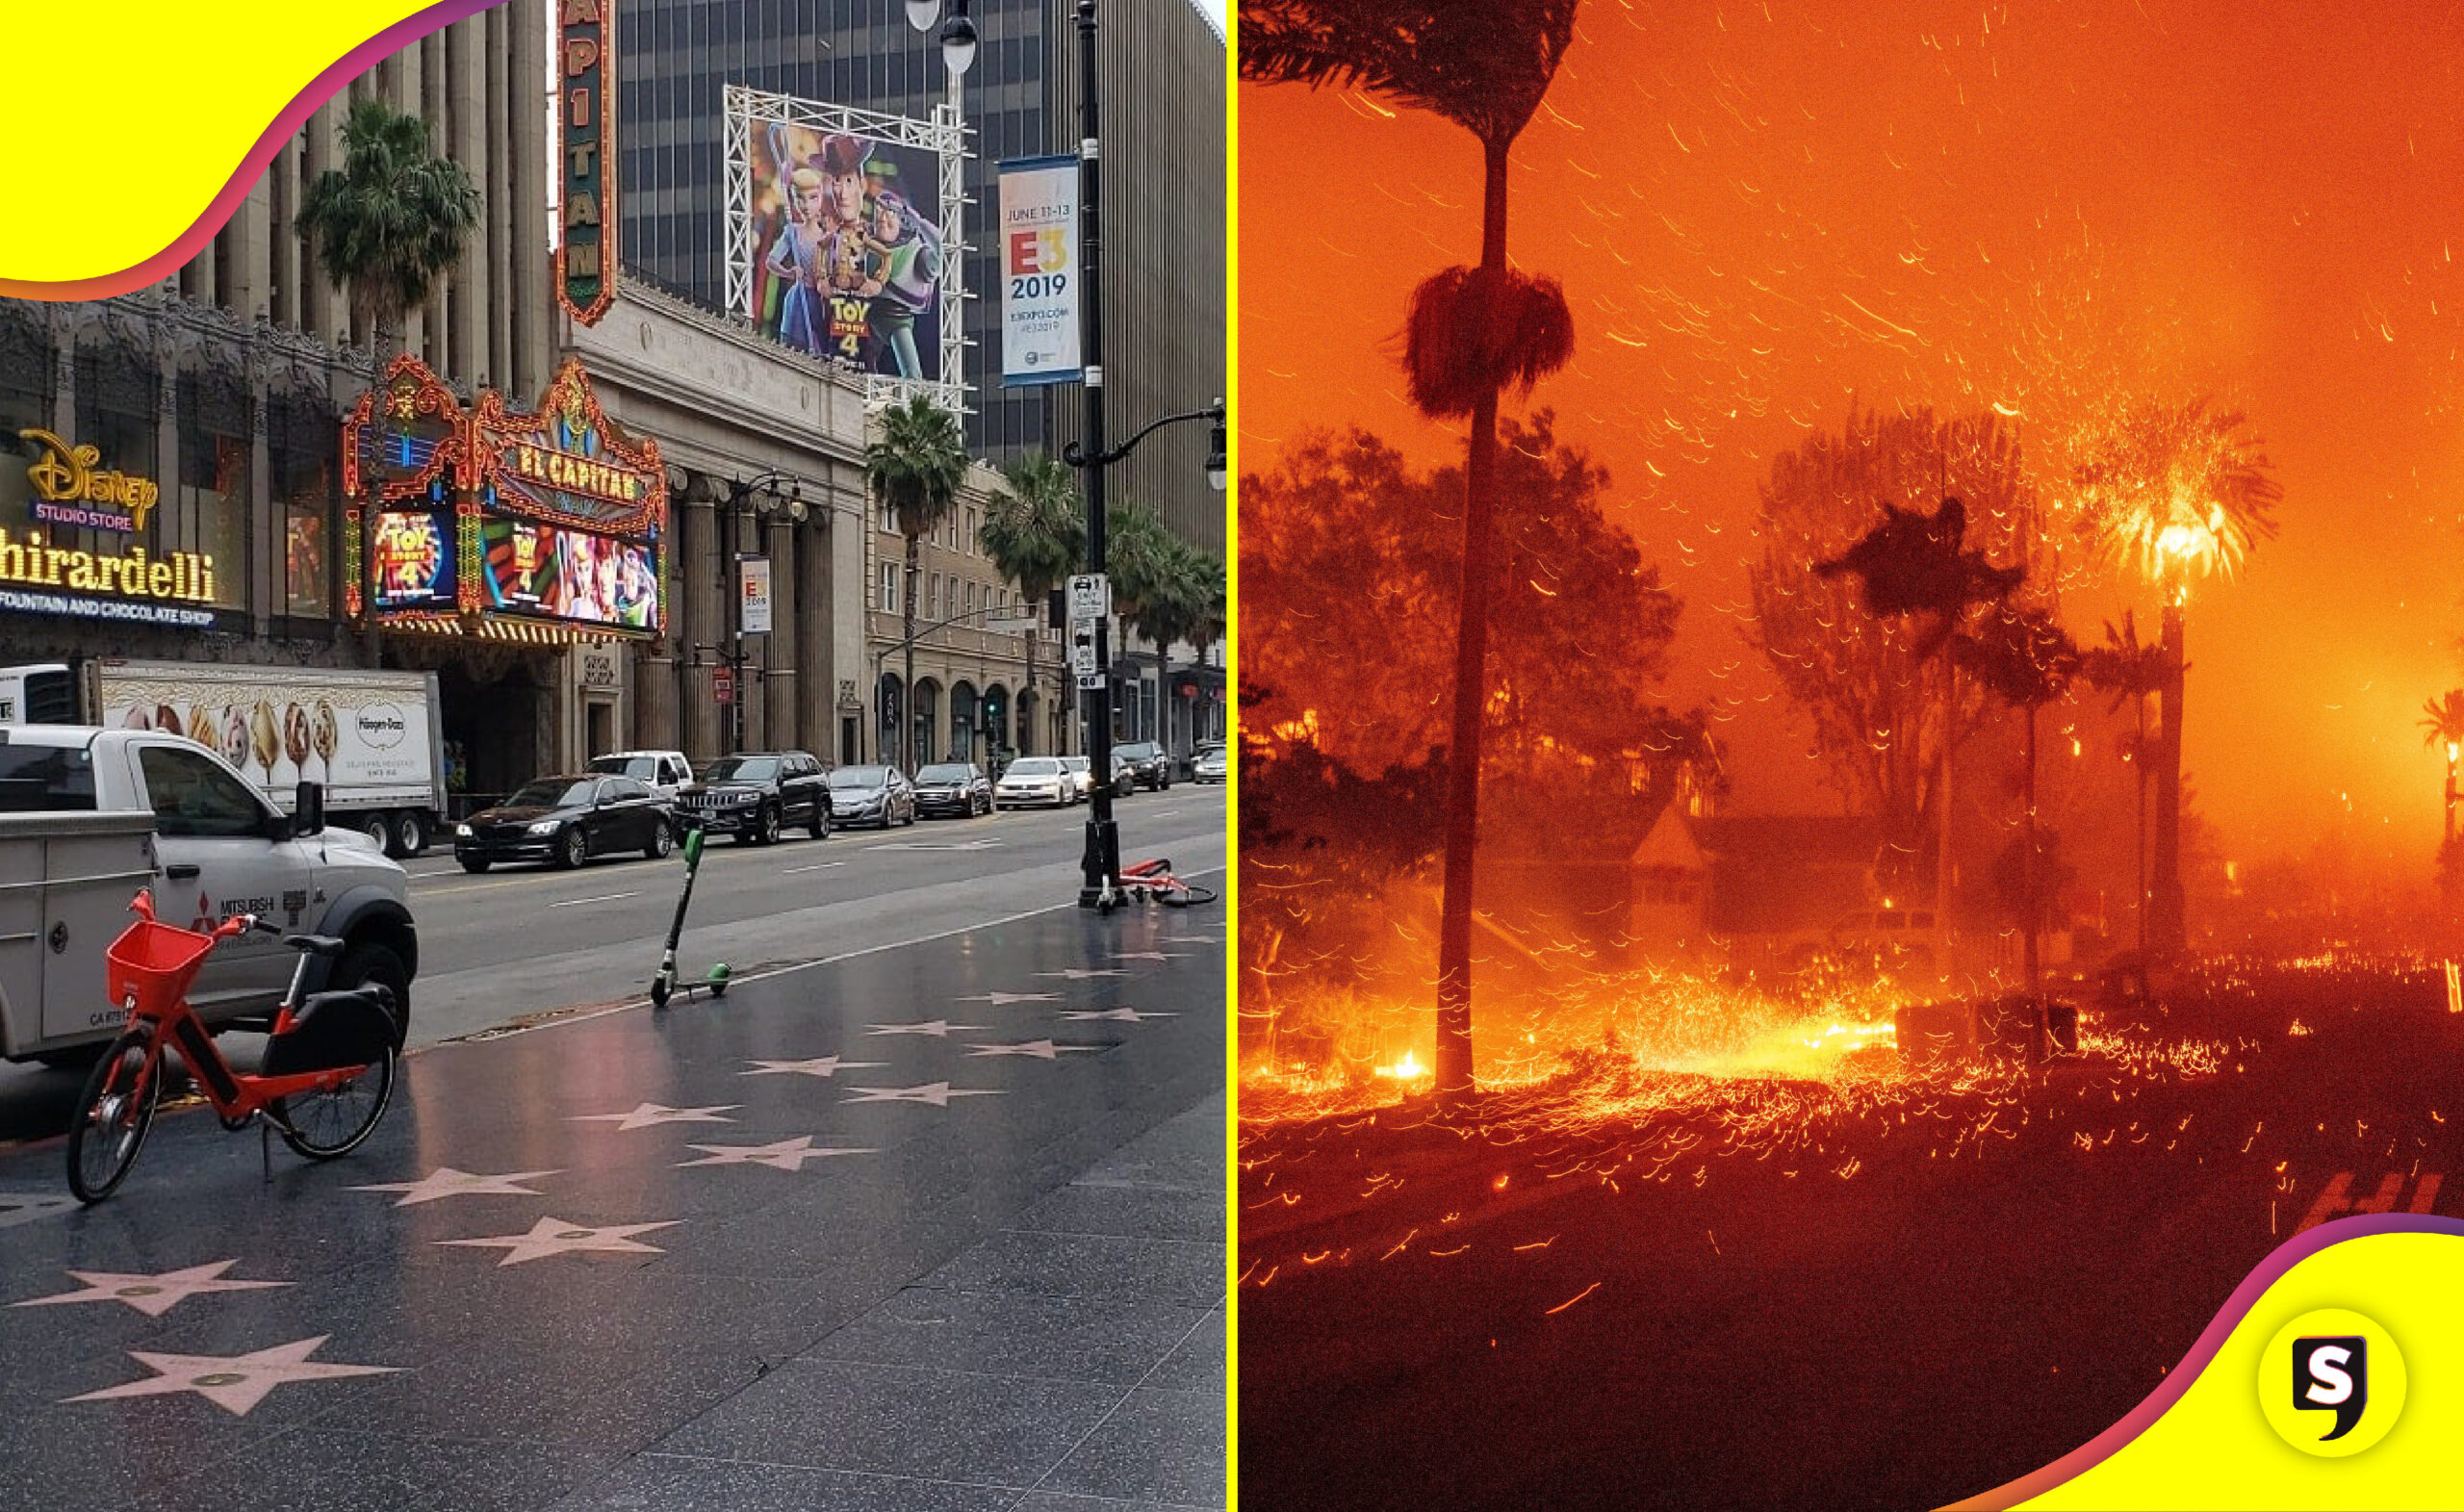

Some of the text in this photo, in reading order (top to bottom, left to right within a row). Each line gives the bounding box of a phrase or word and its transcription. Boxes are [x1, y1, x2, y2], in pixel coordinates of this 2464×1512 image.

[1008, 205, 1070, 221] JUNE 11-13
[1011, 227, 1068, 276] E3
[1011, 273, 1067, 300] 2019
[830, 298, 871, 322] TOY
[840, 334, 860, 356] 4
[521, 446, 545, 476] EL
[37, 503, 133, 530] STUDIO STORE
[388, 529, 429, 551] TOY
[0, 527, 215, 602] hirardelli
[399, 562, 419, 585] 4
[0, 591, 214, 626] FOUNTAIN AND CHOCOLATE SHOP
